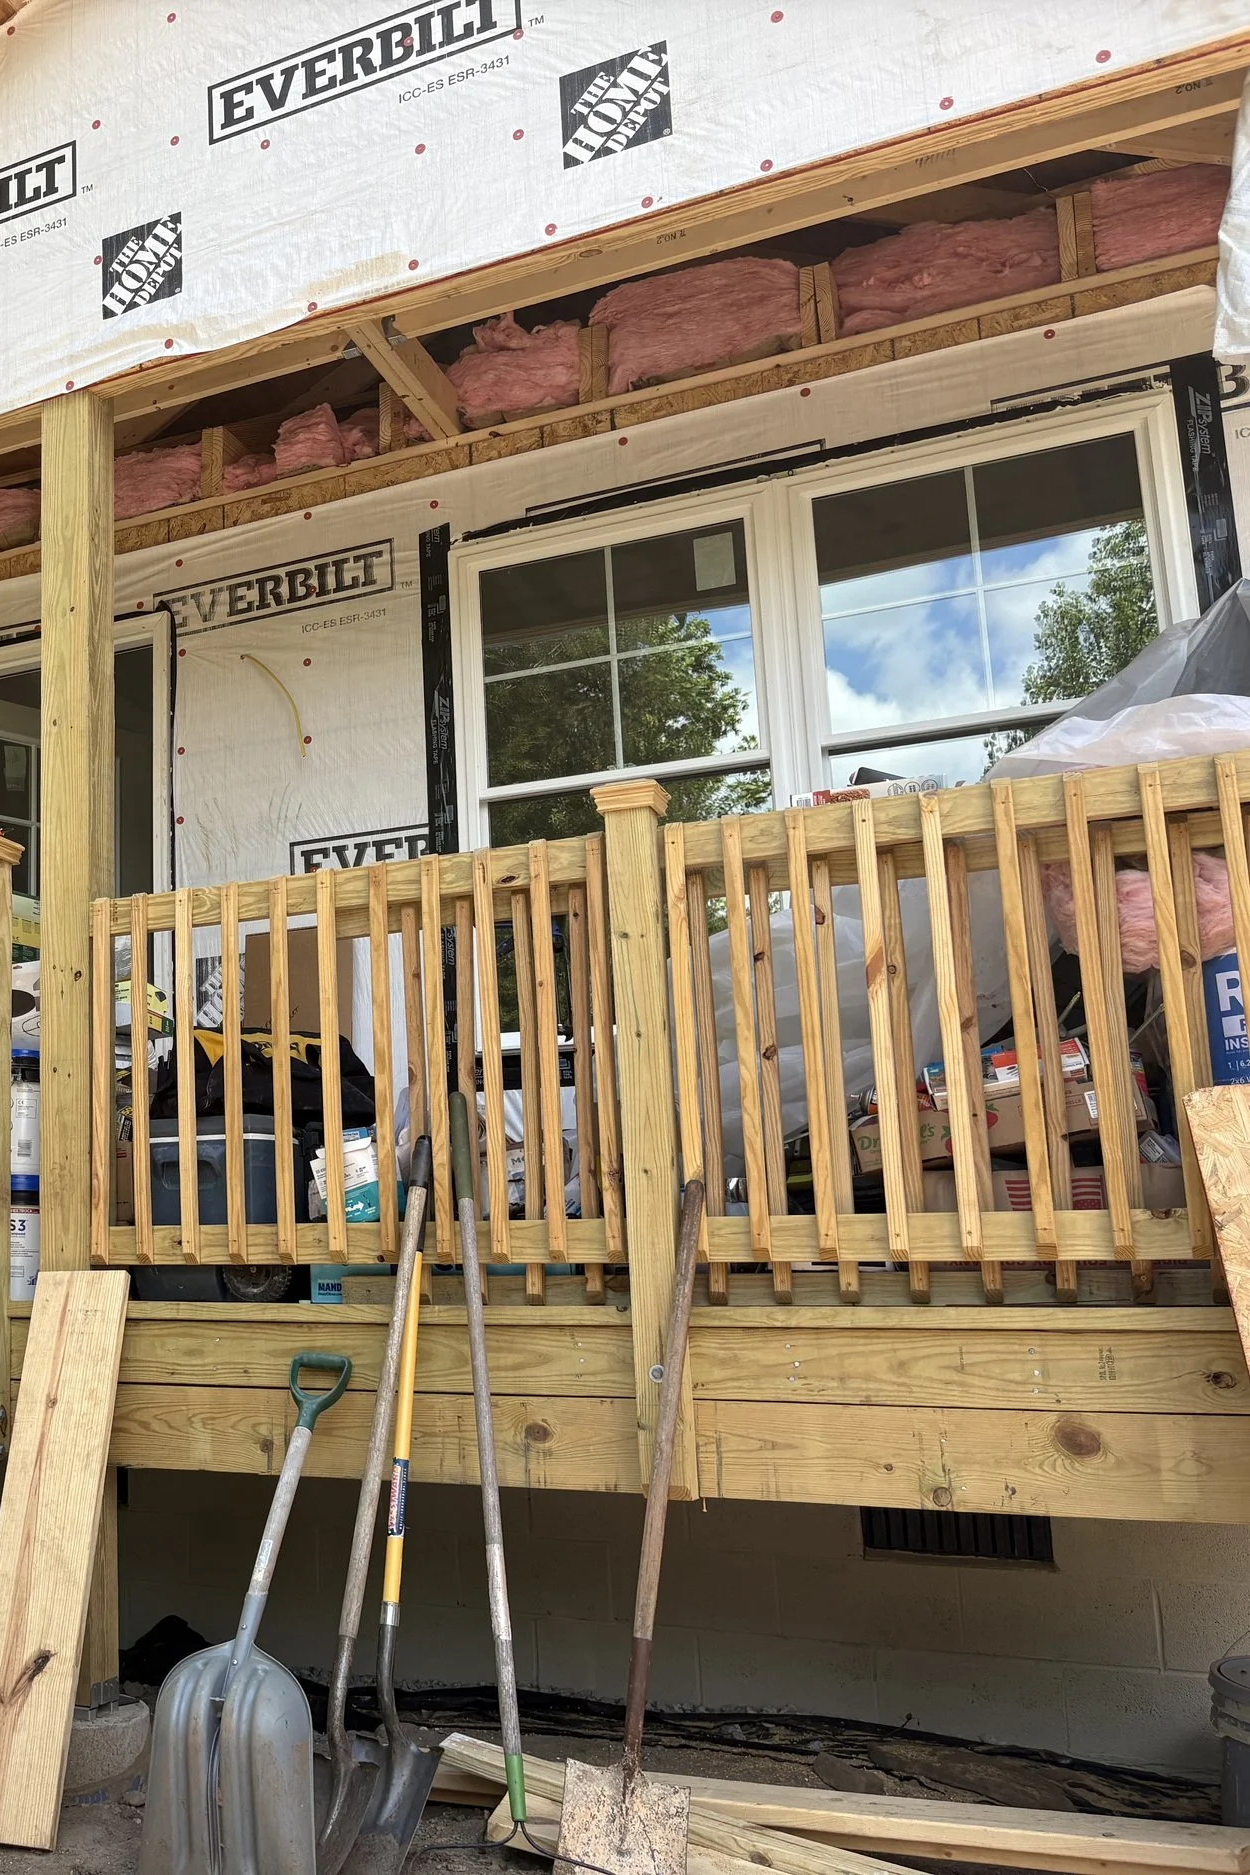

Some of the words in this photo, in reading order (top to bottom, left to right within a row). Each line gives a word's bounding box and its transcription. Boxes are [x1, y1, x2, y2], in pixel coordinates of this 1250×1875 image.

[220, 0, 498, 130] EVERBILT
[398, 78, 444, 104] ICC-ES
[448, 55, 511, 87] ESR-3431
[562, 46, 669, 162] HOME
[570, 71, 615, 115] THE
[604, 77, 670, 152] DEPOT
[20, 217, 67, 242] ESR-3431
[109, 236, 143, 273] THE
[102, 216, 182, 316] HOME
[133, 243, 182, 305] DEPOT
[171, 550, 383, 628] EVERBILT
[302, 619, 337, 633] ICC-ES
[339, 608, 387, 626] ESR-3431
[301, 834, 429, 873] EVER
